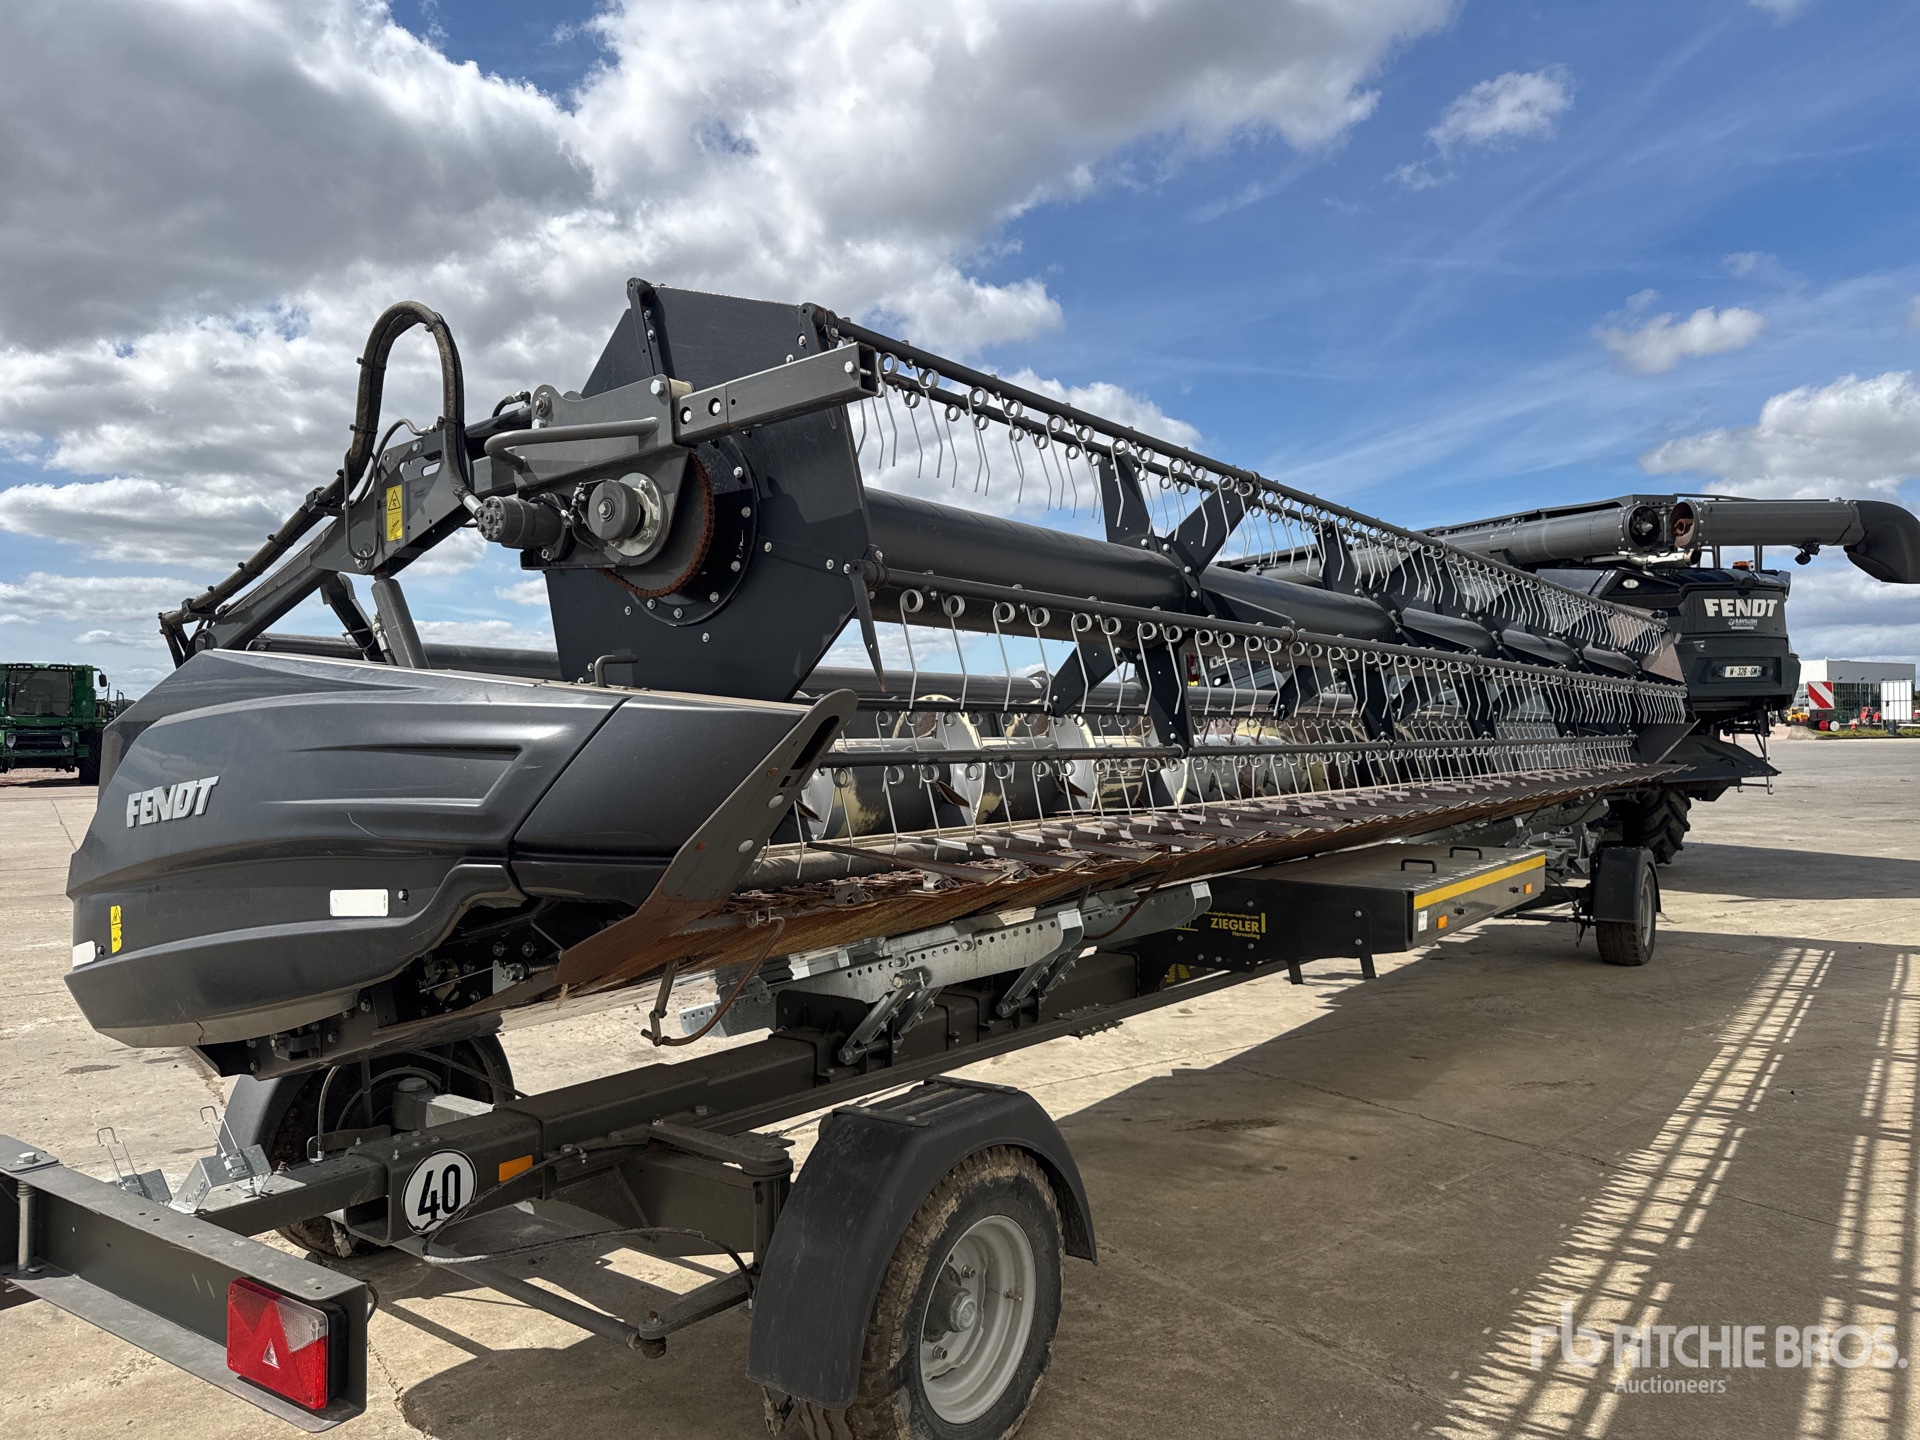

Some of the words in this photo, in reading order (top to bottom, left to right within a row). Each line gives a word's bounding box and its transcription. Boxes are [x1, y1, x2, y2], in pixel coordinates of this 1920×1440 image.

[1703, 598, 1778, 617] FENDT
[126, 775, 220, 828] FENDT
[1210, 918, 1260, 933] ZIEGLER
[1231, 931, 1260, 940] Harvesting
[417, 1164, 461, 1220] 40
